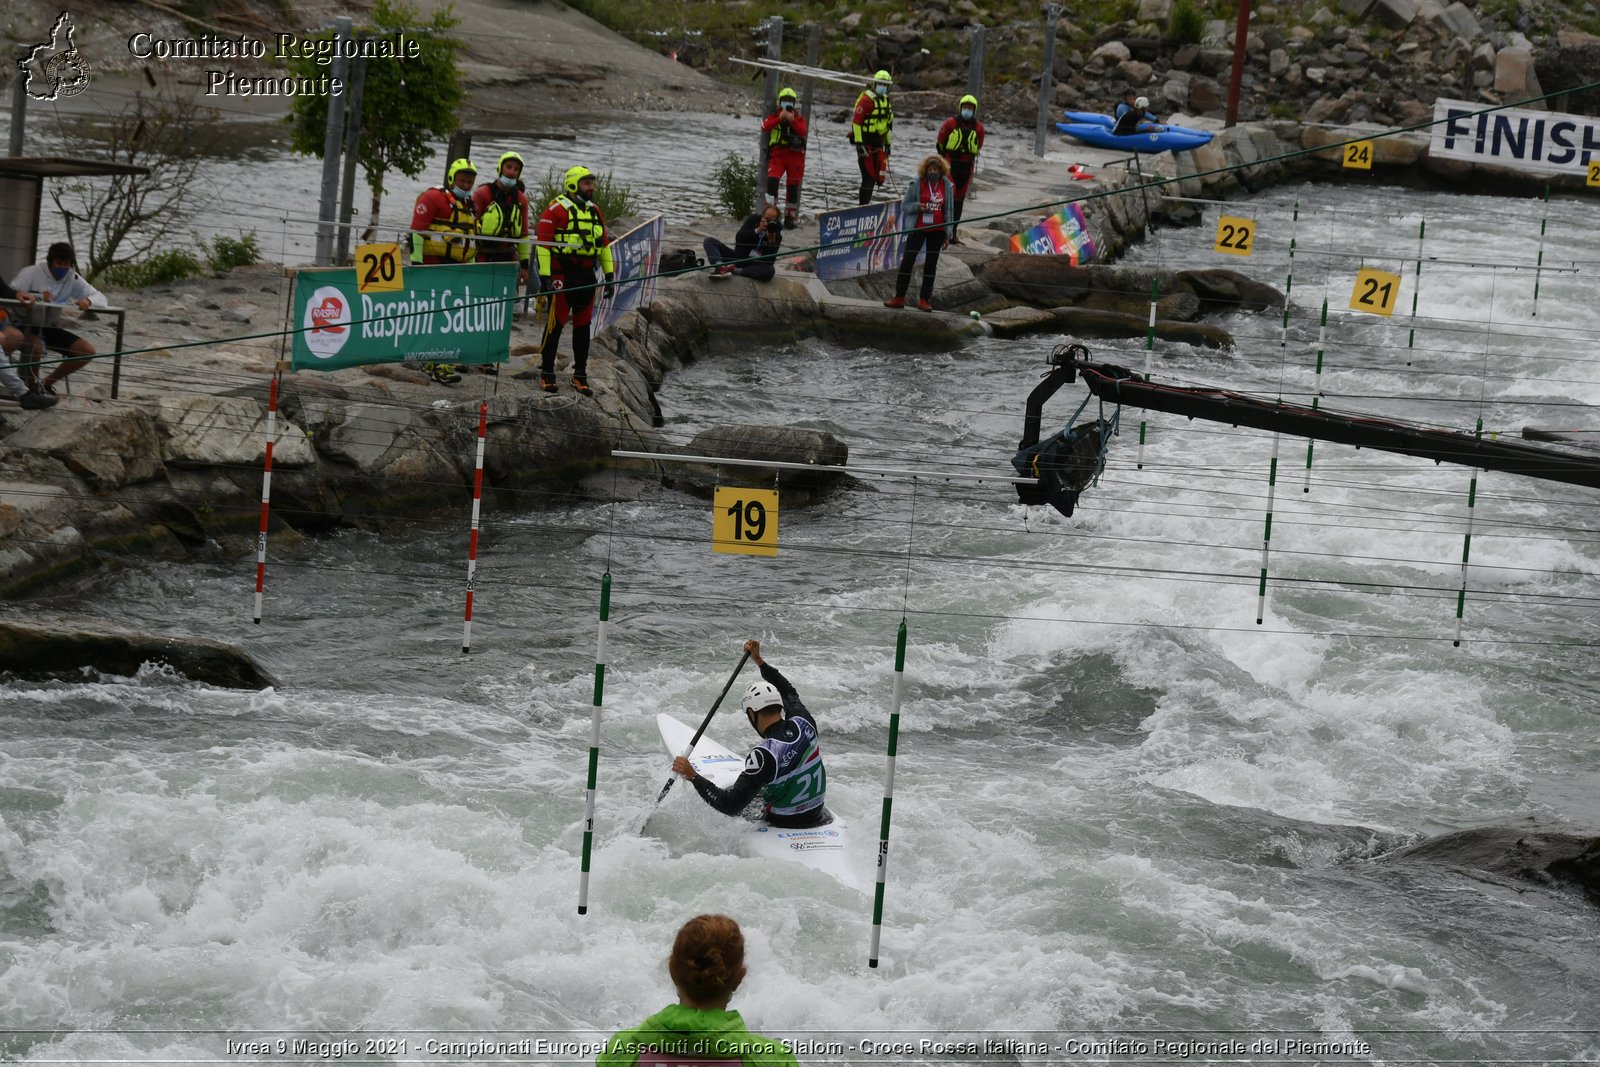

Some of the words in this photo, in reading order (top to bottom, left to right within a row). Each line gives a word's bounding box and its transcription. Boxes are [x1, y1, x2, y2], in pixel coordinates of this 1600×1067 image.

[1347, 145, 1369, 164] 24
[827, 216, 841, 232] ECA
[858, 215, 878, 232] IVREA
[1220, 225, 1250, 250] 22
[362, 252, 396, 283] 20
[1359, 278, 1392, 309] 21
[312, 308, 341, 318] RASPINI
[361, 289, 437, 347] Raspini
[440, 285, 508, 335] Salumi
[728, 500, 766, 542] 19
[782, 749, 799, 763] ECA
[790, 764, 824, 805] 21
[879, 841, 888, 855] 19
